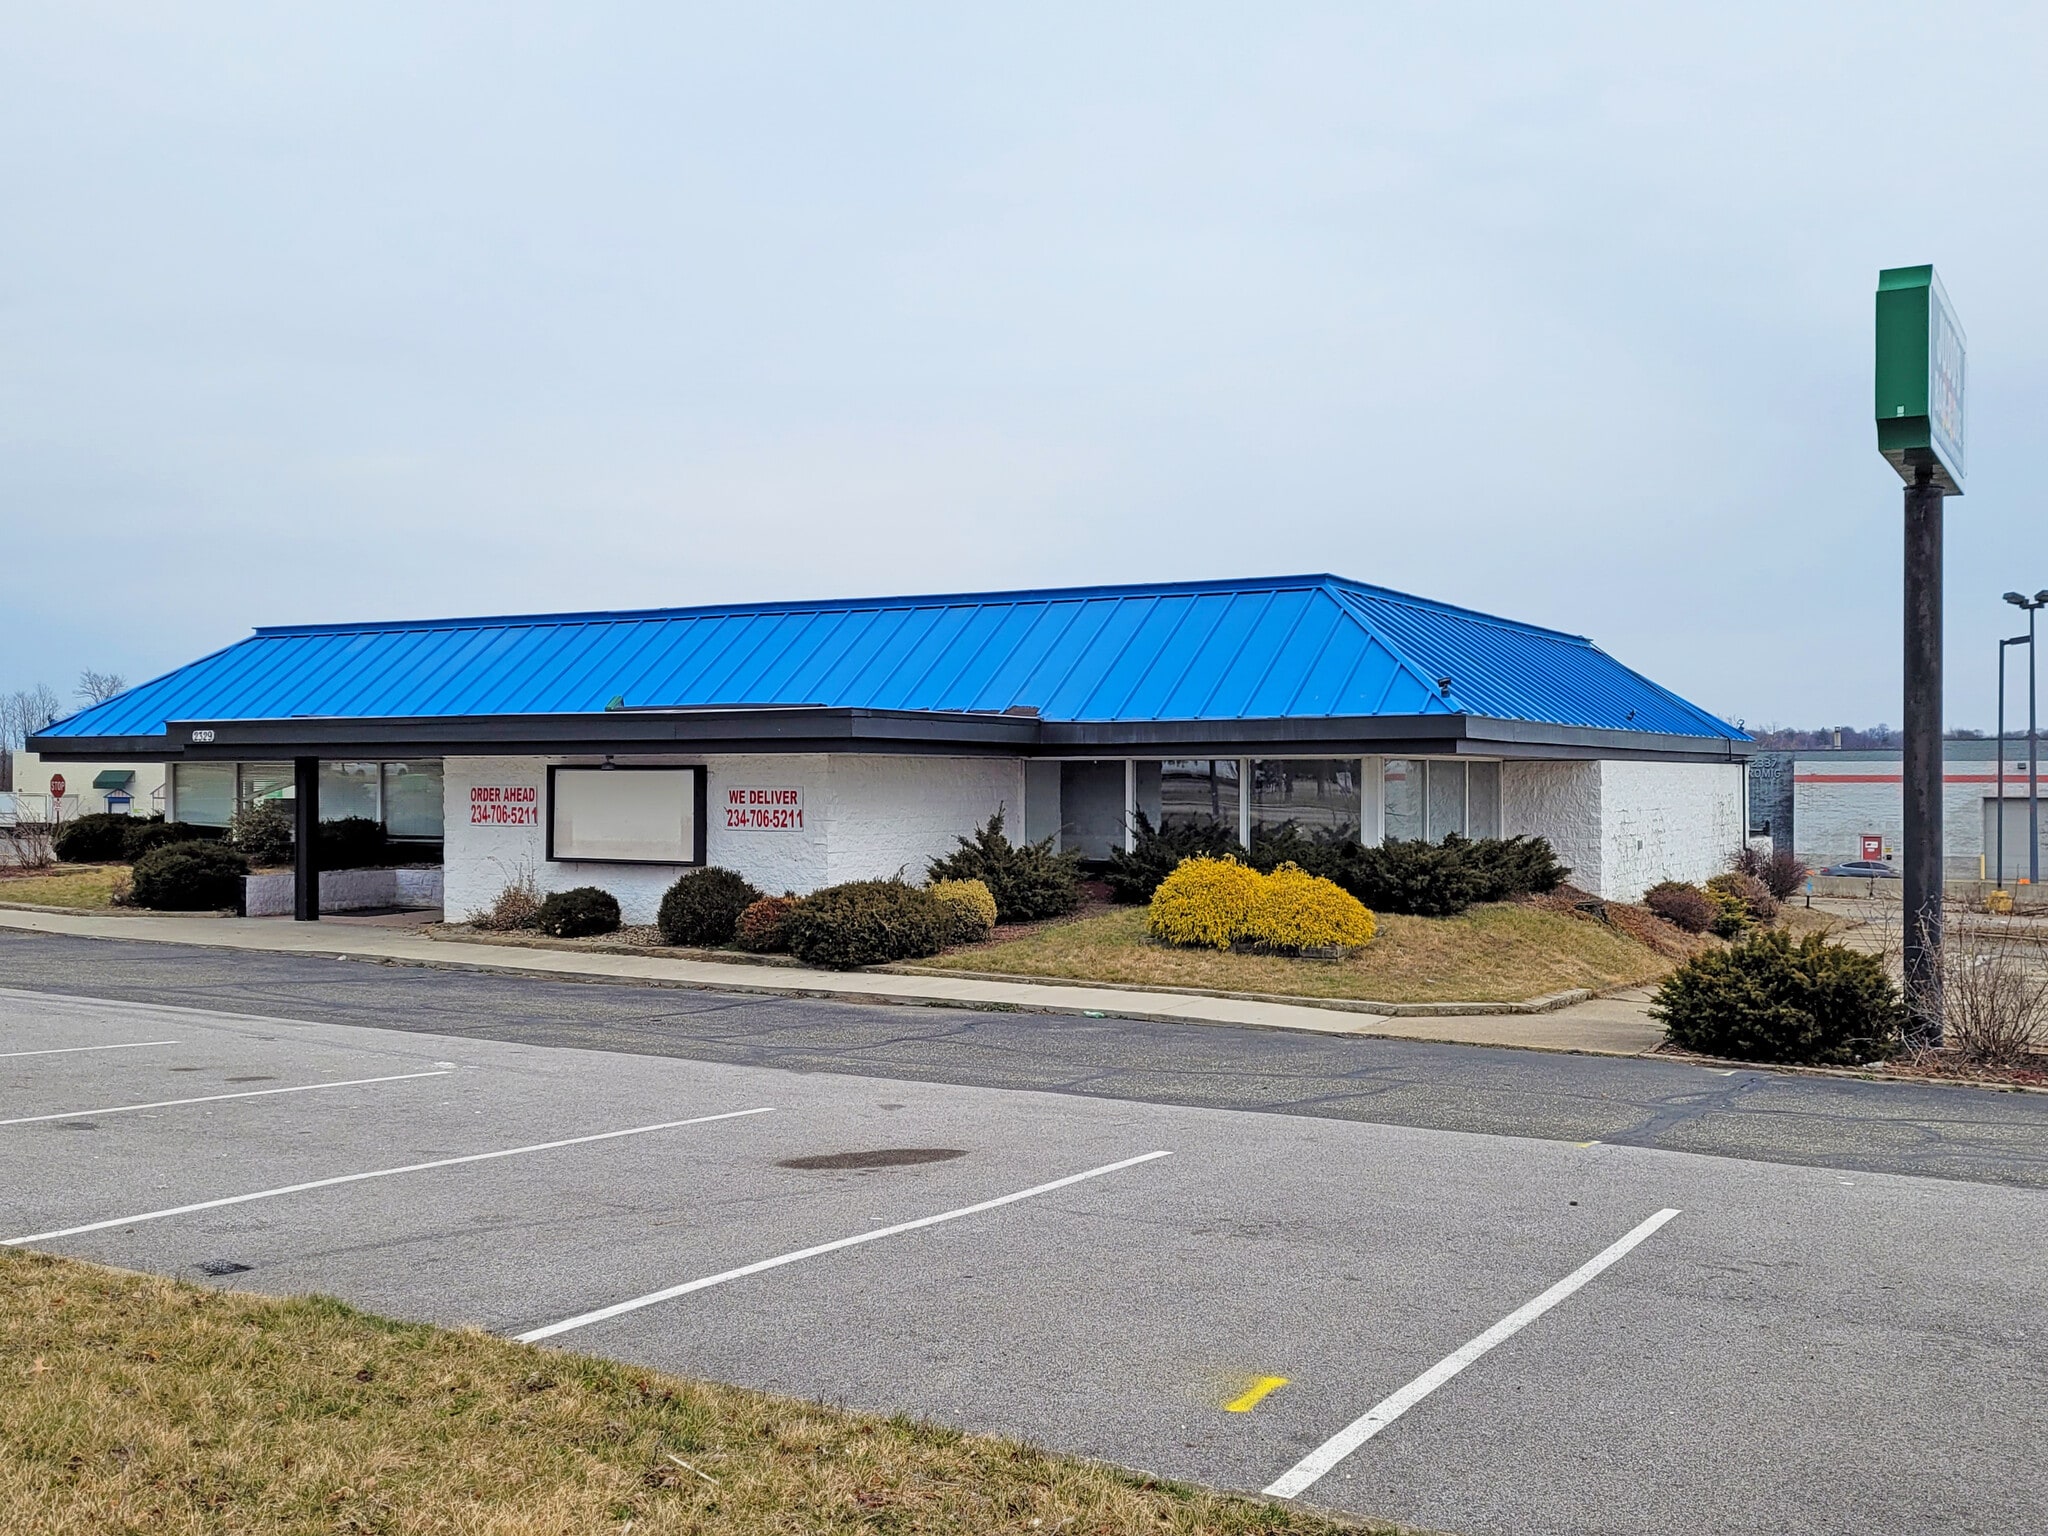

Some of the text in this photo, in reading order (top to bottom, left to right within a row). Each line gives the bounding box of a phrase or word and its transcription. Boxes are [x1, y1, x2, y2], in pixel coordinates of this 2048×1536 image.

[51, 781, 65, 791] STOP
[470, 787, 535, 802] ORDER AHEAD
[728, 789, 798, 805] WE DELIVER
[470, 804, 538, 824] 234-706-5211
[726, 808, 803, 828] 234-706-5211
